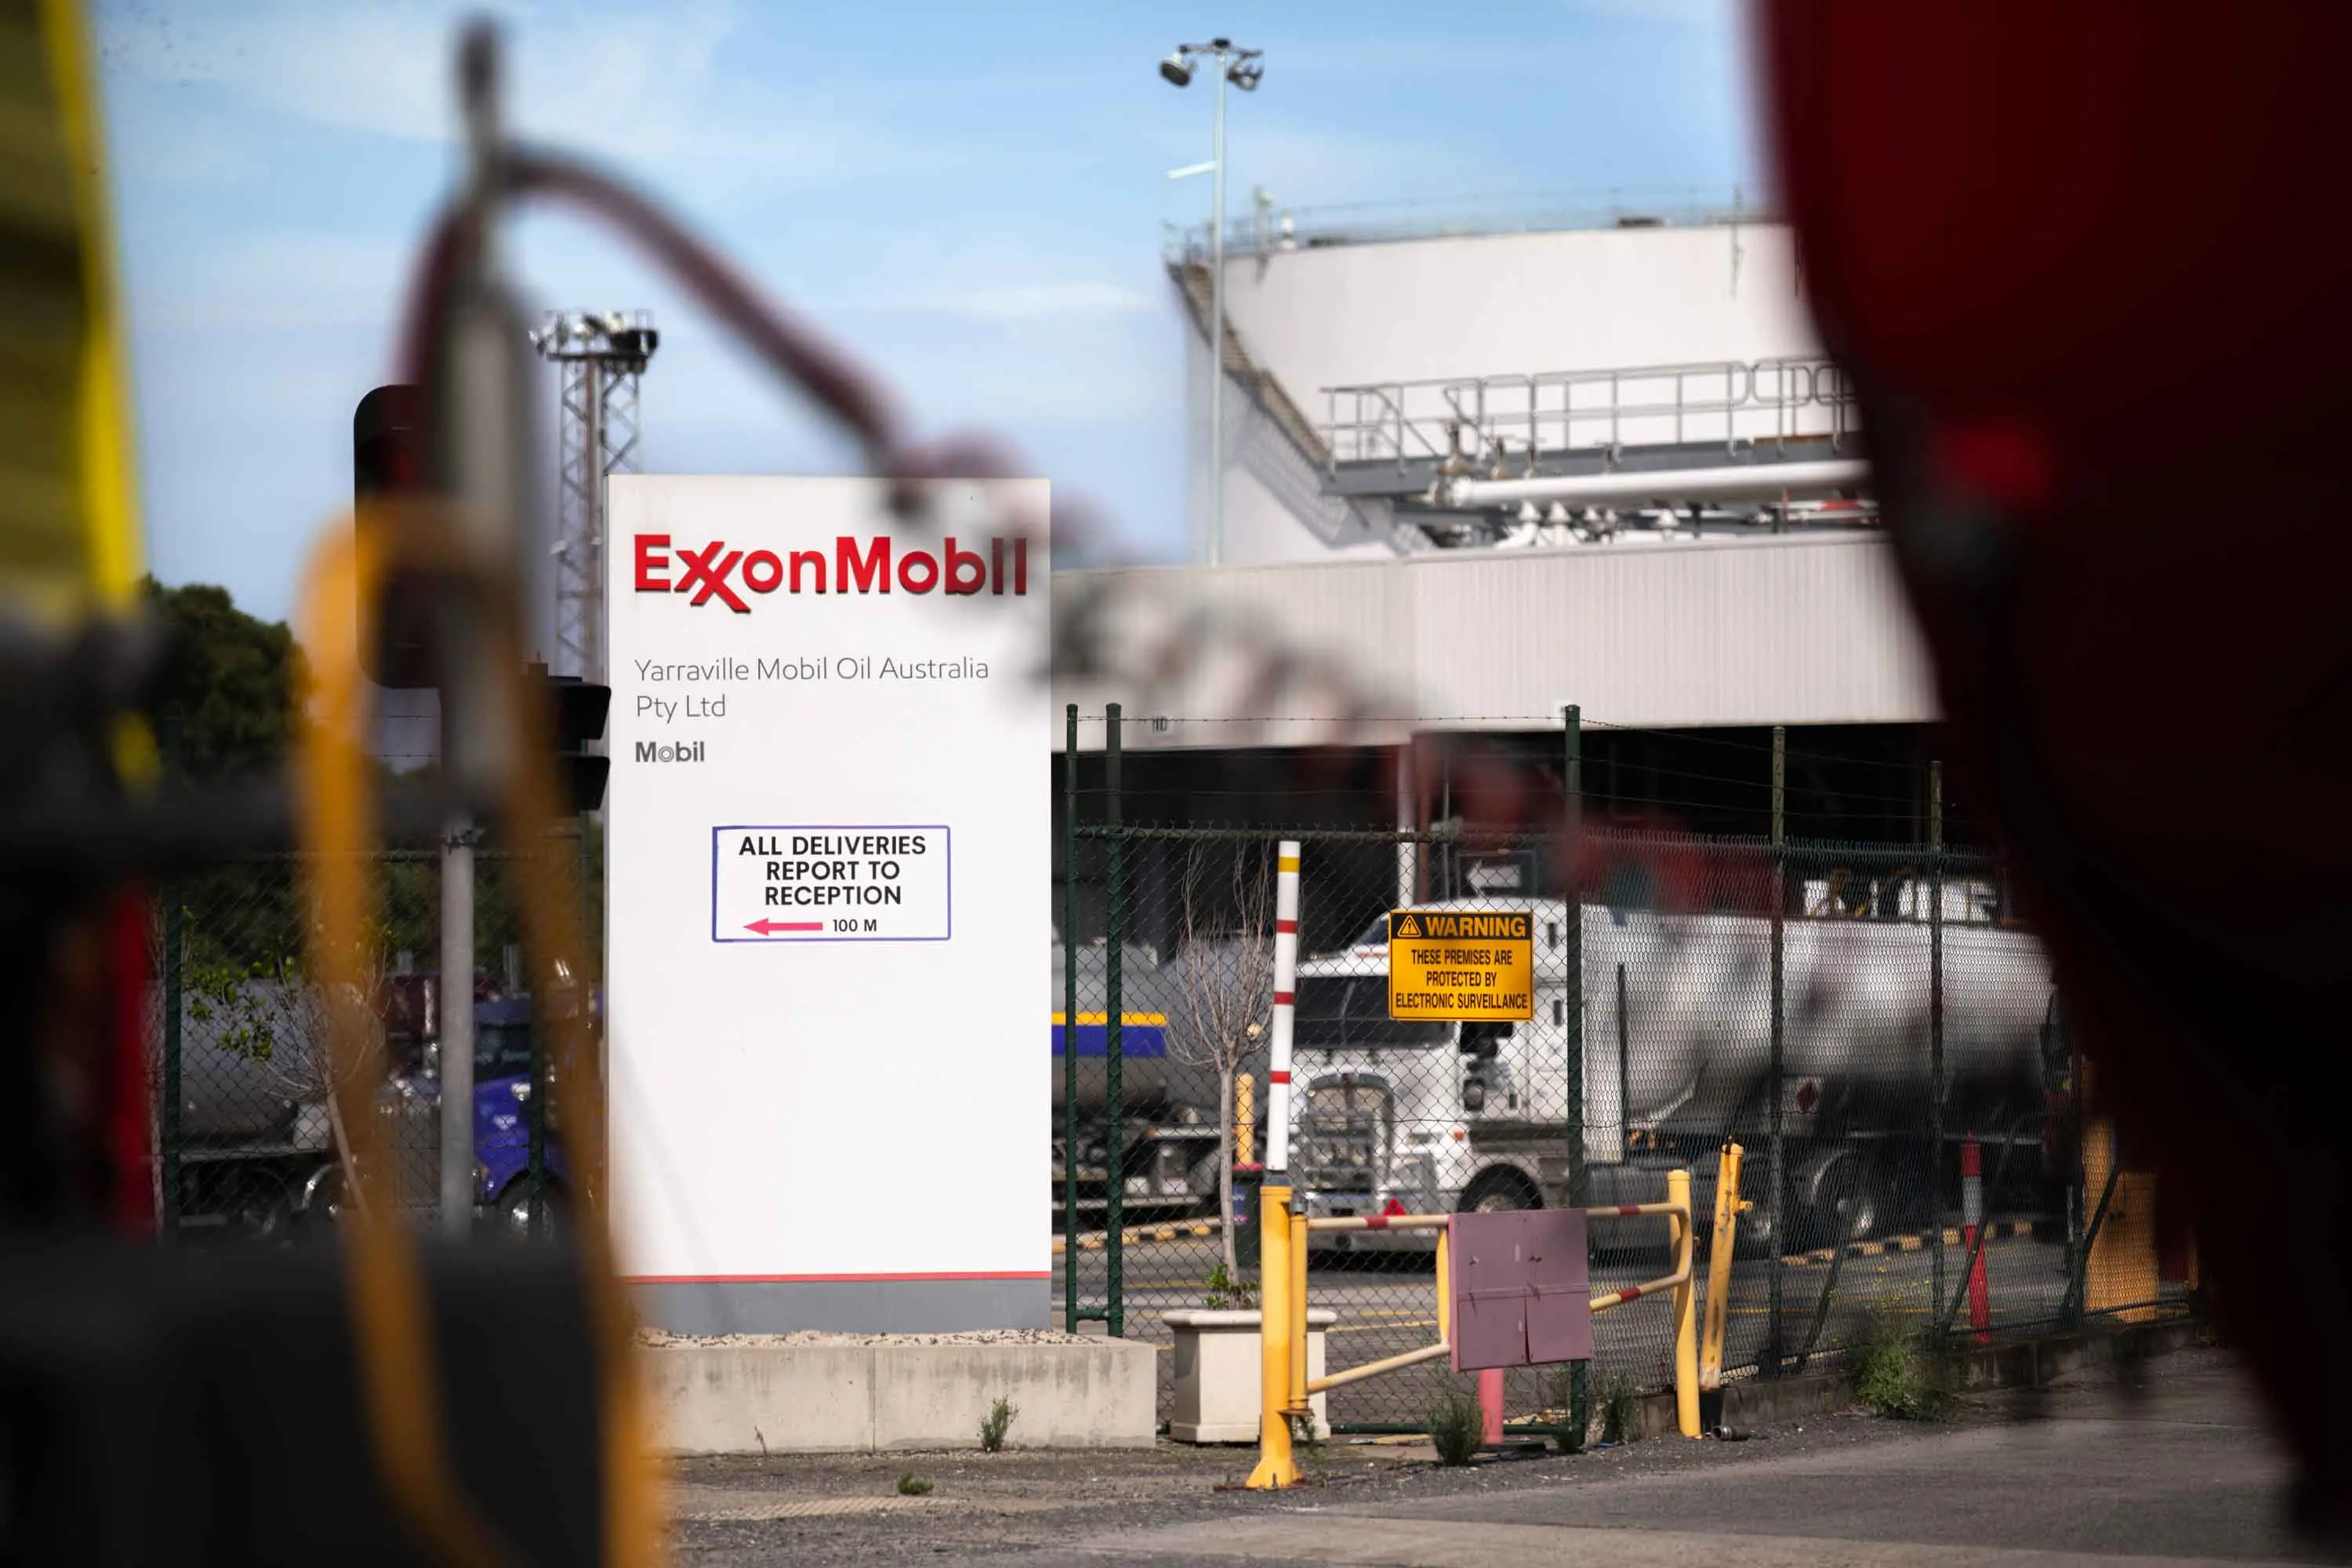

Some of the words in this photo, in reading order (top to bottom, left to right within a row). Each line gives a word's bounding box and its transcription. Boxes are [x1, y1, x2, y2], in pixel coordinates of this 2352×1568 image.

[633, 534, 1027, 613] ExxonMobil
[634, 657, 750, 681] Yarraville
[757, 656, 827, 681] Mobil
[837, 656, 870, 680] Oil
[879, 656, 989, 679] Australia
[637, 695, 677, 724] Pty
[686, 695, 726, 717] Ltd
[635, 742, 705, 763] Mobil
[739, 836, 782, 856] ALL
[792, 835, 927, 855] DELIVERIES
[766, 861, 859, 880] REPORT
[868, 860, 900, 880] TO
[764, 885, 902, 906] RECEPTION
[833, 919, 858, 932] 100
[863, 918, 877, 932] M
[1425, 916, 1526, 937] WARNING
[1411, 949, 1441, 965] THESE
[1444, 949, 1490, 965] PREMISES
[1494, 949, 1513, 965] ARE
[1426, 971, 1482, 987] PROTECTED
[1485, 972, 1497, 987] BY
[1396, 993, 1454, 1008] ELECTRONIC
[1457, 993, 1528, 1009] SURVEILLANCE
